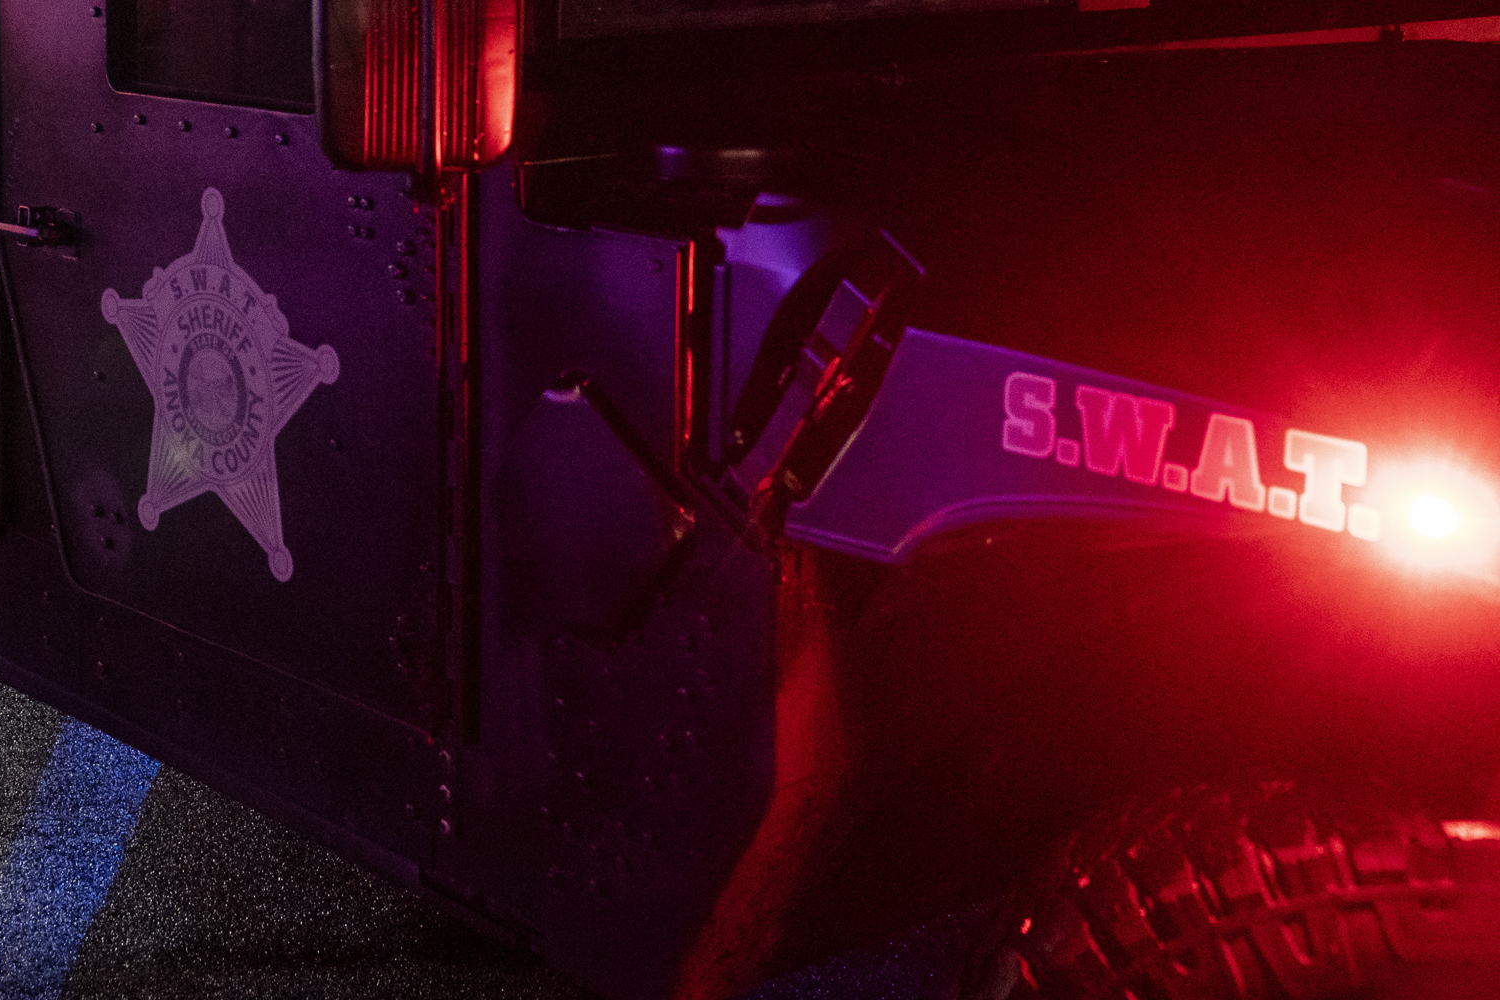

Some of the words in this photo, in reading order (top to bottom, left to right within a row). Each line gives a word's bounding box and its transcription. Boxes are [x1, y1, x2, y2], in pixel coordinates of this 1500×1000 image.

[177, 305, 252, 353] SHERIFF
[163, 367, 204, 468] ANOKA
[211, 390, 264, 475] COUNTY
[1002, 371, 1382, 543] S.W.A.T.
